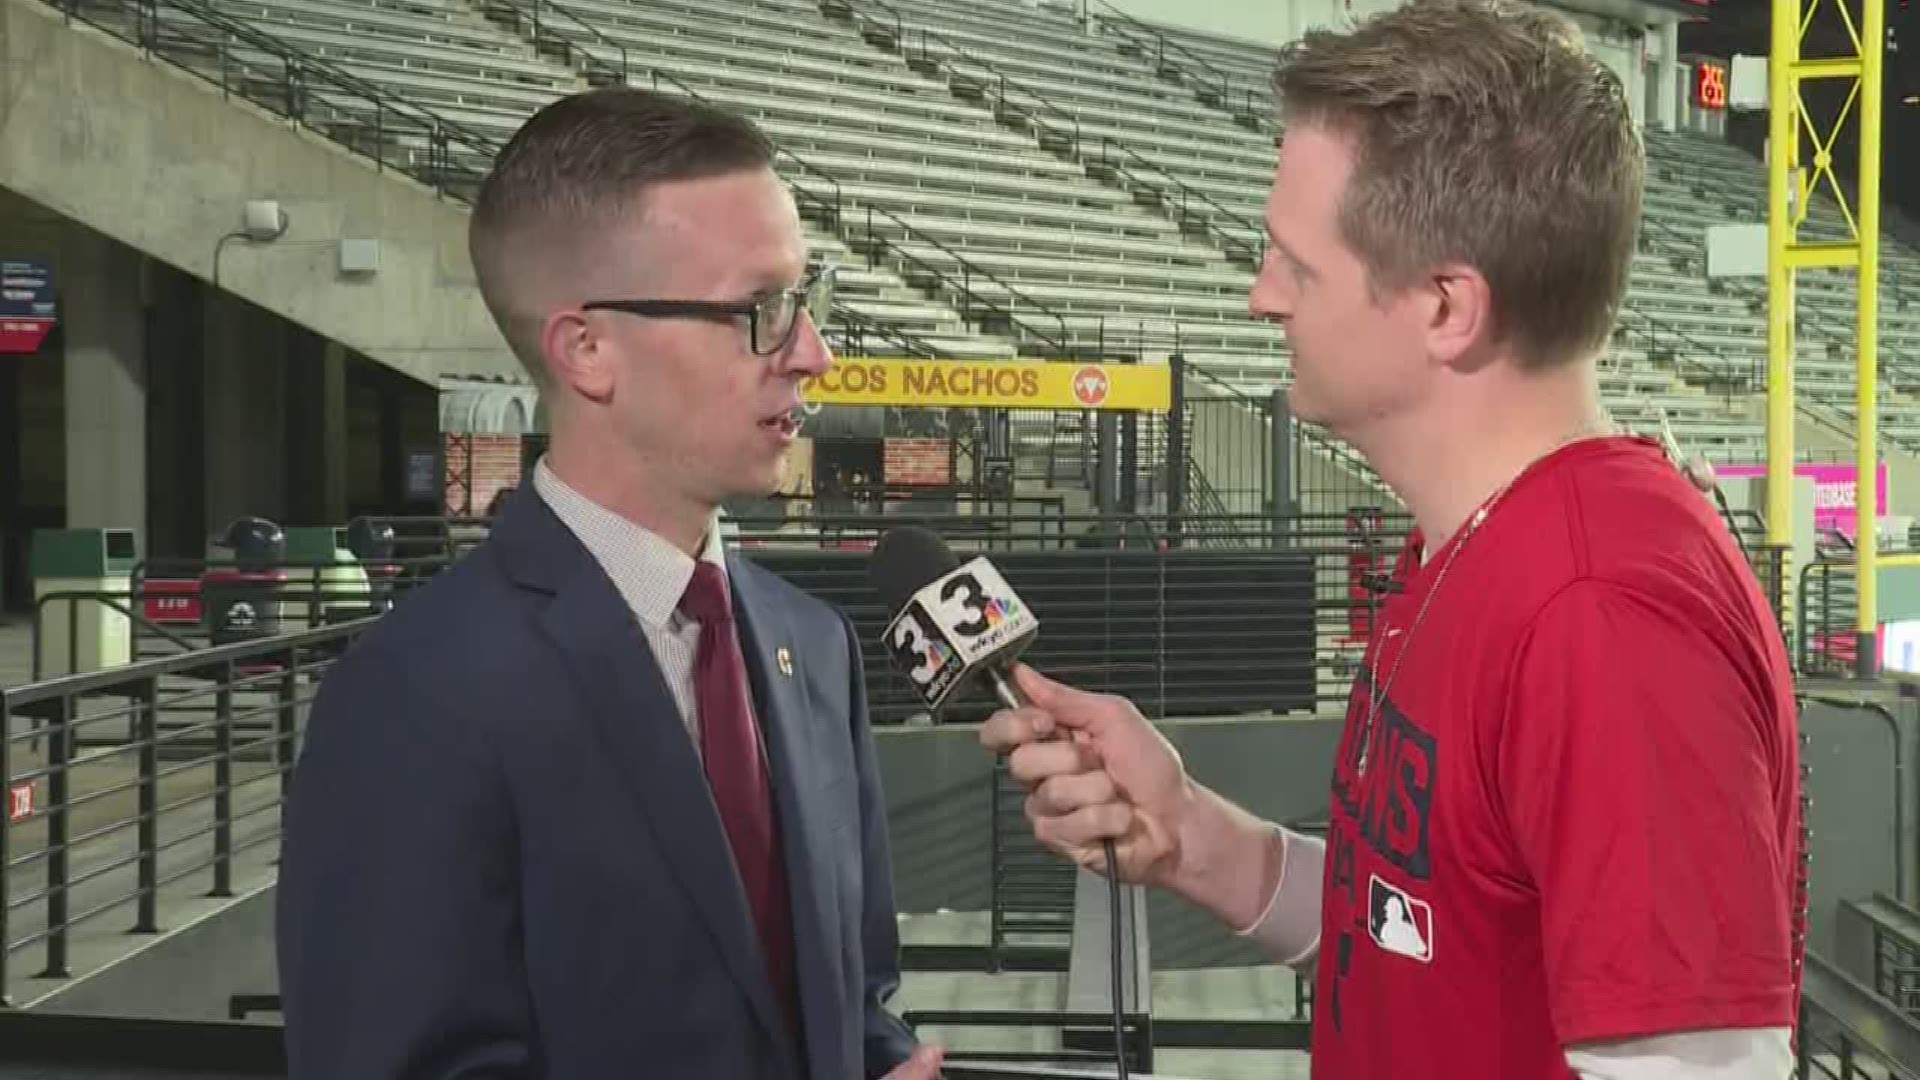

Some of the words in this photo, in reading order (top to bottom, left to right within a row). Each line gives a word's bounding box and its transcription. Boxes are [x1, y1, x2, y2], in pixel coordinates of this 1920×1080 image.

[902, 367, 1039, 396] NACHOS
[941, 573, 991, 636] 3
[893, 611, 931, 685] 3
